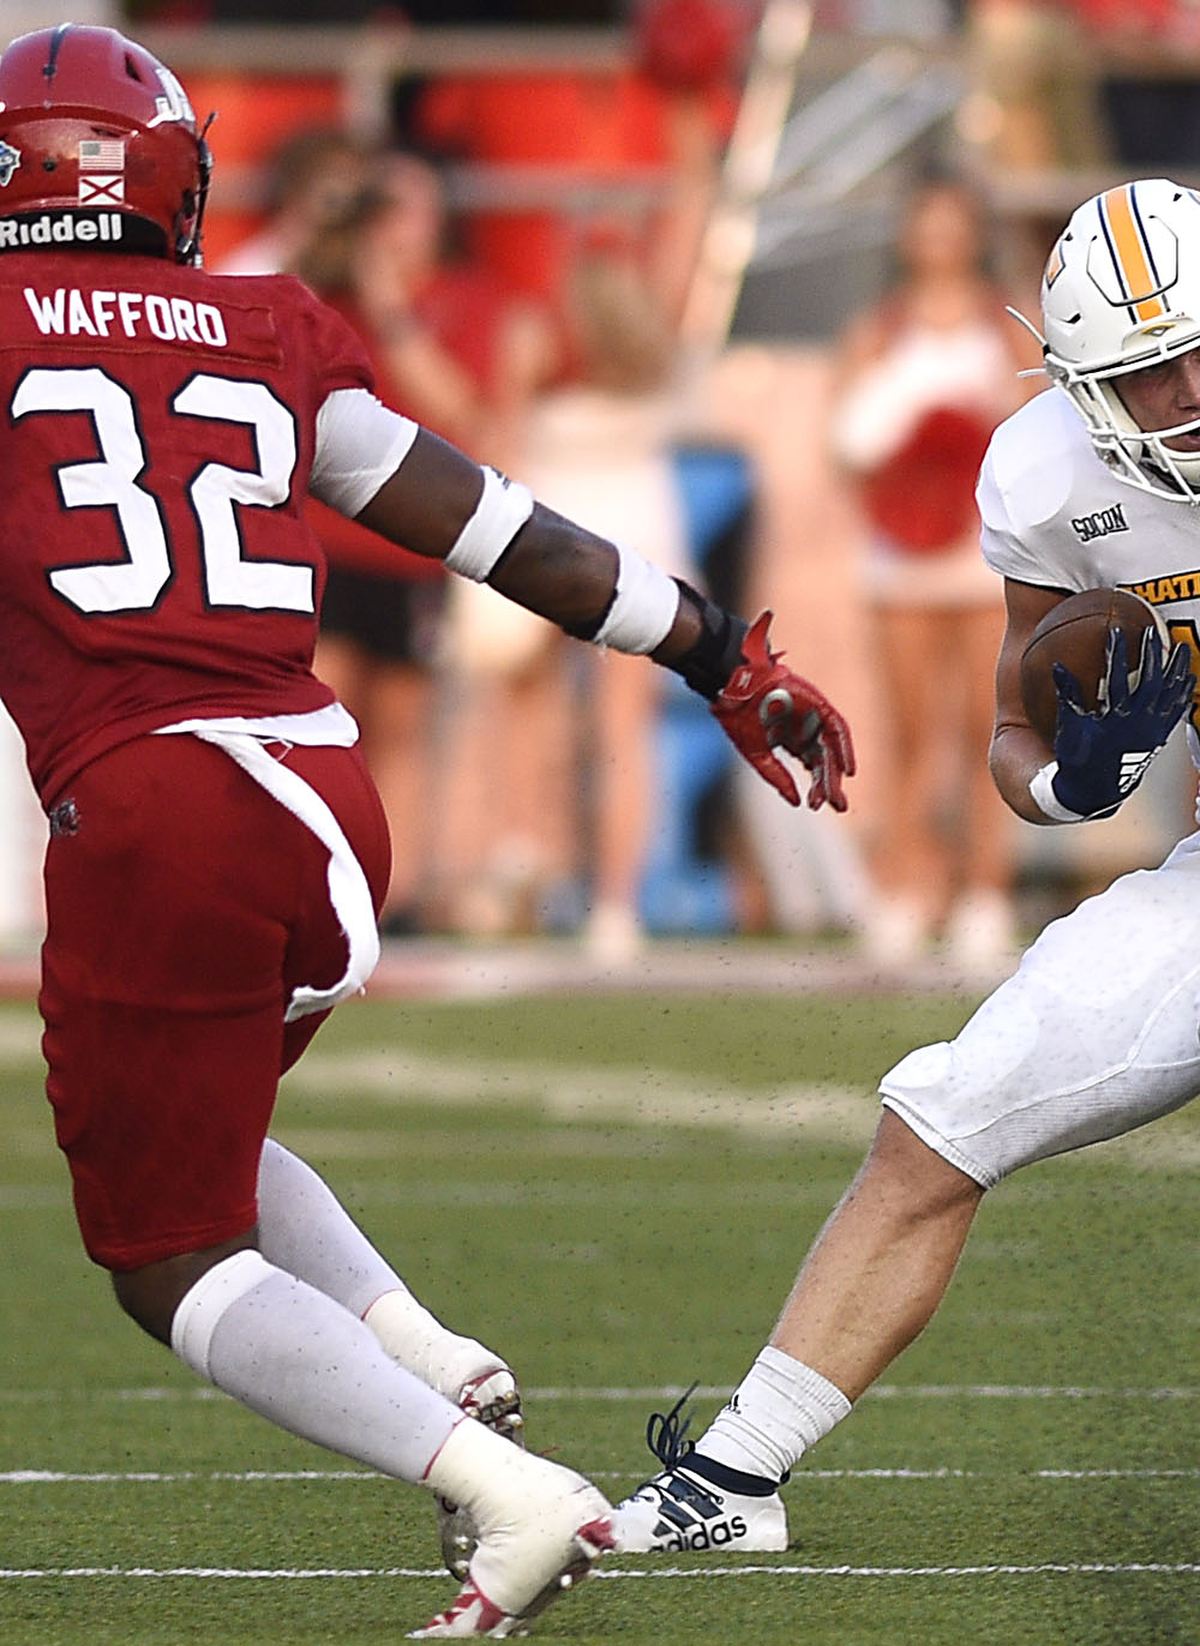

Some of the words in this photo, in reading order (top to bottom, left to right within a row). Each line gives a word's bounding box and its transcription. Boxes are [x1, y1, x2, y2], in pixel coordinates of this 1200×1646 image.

[0, 213, 122, 247] Riddell
[24, 288, 227, 346] WAFFORD
[10, 366, 315, 613] 32
[1071, 503, 1130, 542] SOCON
